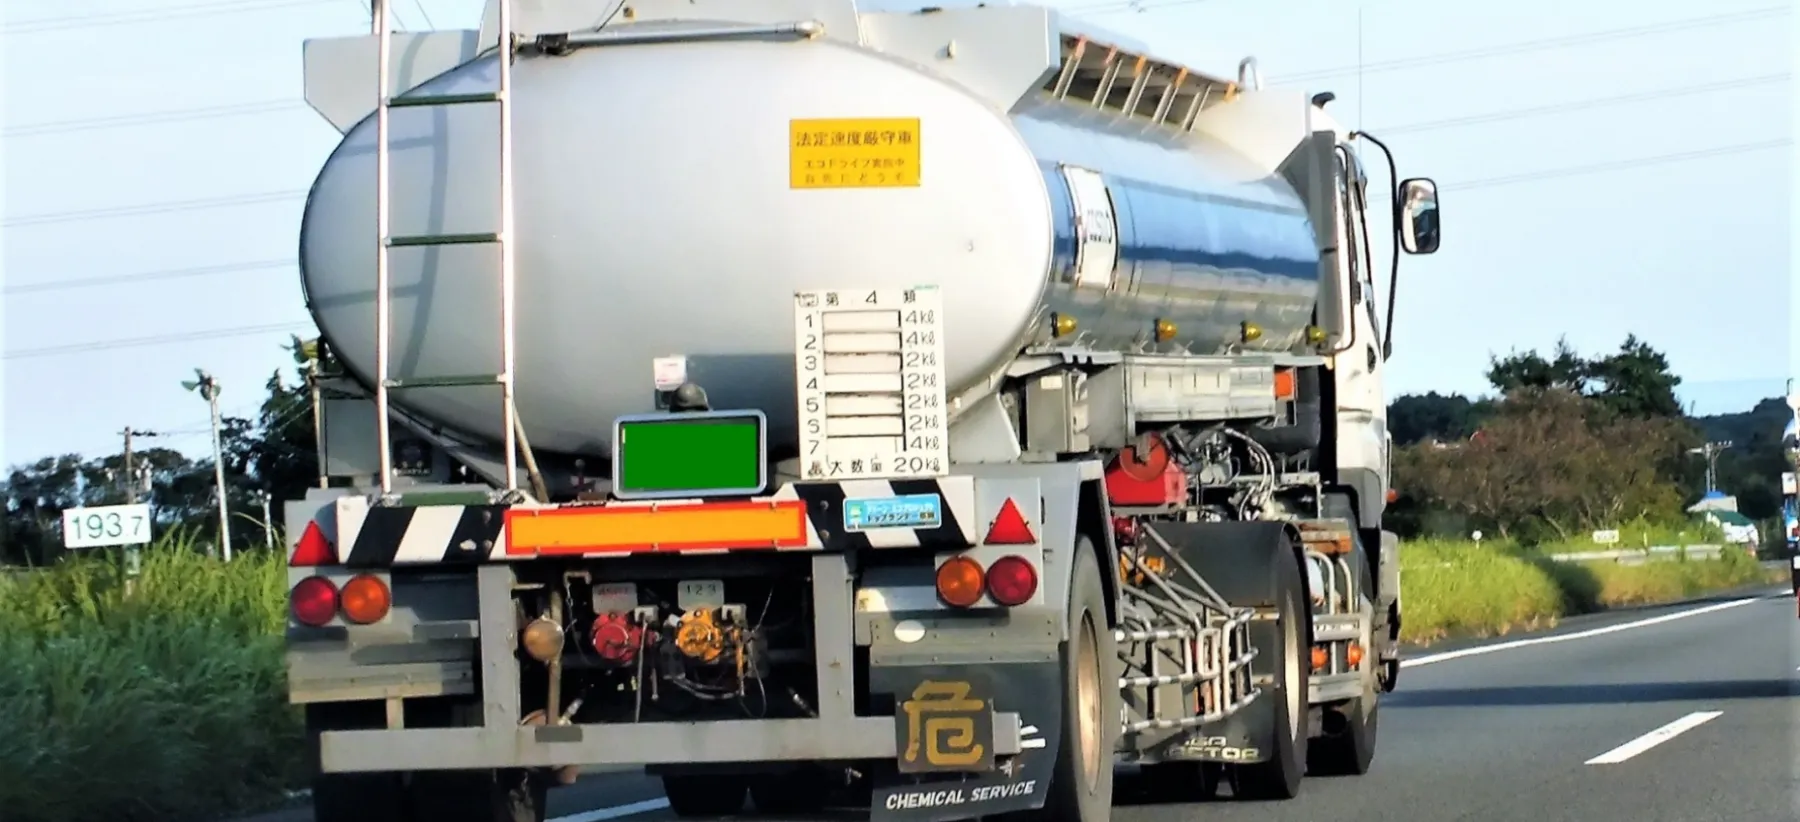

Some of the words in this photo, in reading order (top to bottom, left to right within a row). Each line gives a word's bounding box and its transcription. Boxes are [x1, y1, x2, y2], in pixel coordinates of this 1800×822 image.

[796, 129, 912, 148] 法定速度厳守車
[805, 314, 813, 328] 1
[804, 335, 817, 350] 2
[805, 356, 817, 371] 3
[806, 377, 818, 390] 4
[806, 397, 819, 413] 5
[808, 418, 820, 434] 6
[808, 440, 820, 455] 7
[903, 680, 985, 766] 危
[885, 789, 965, 810] CHEMICAL
[971, 779, 1037, 802] SERVICE
